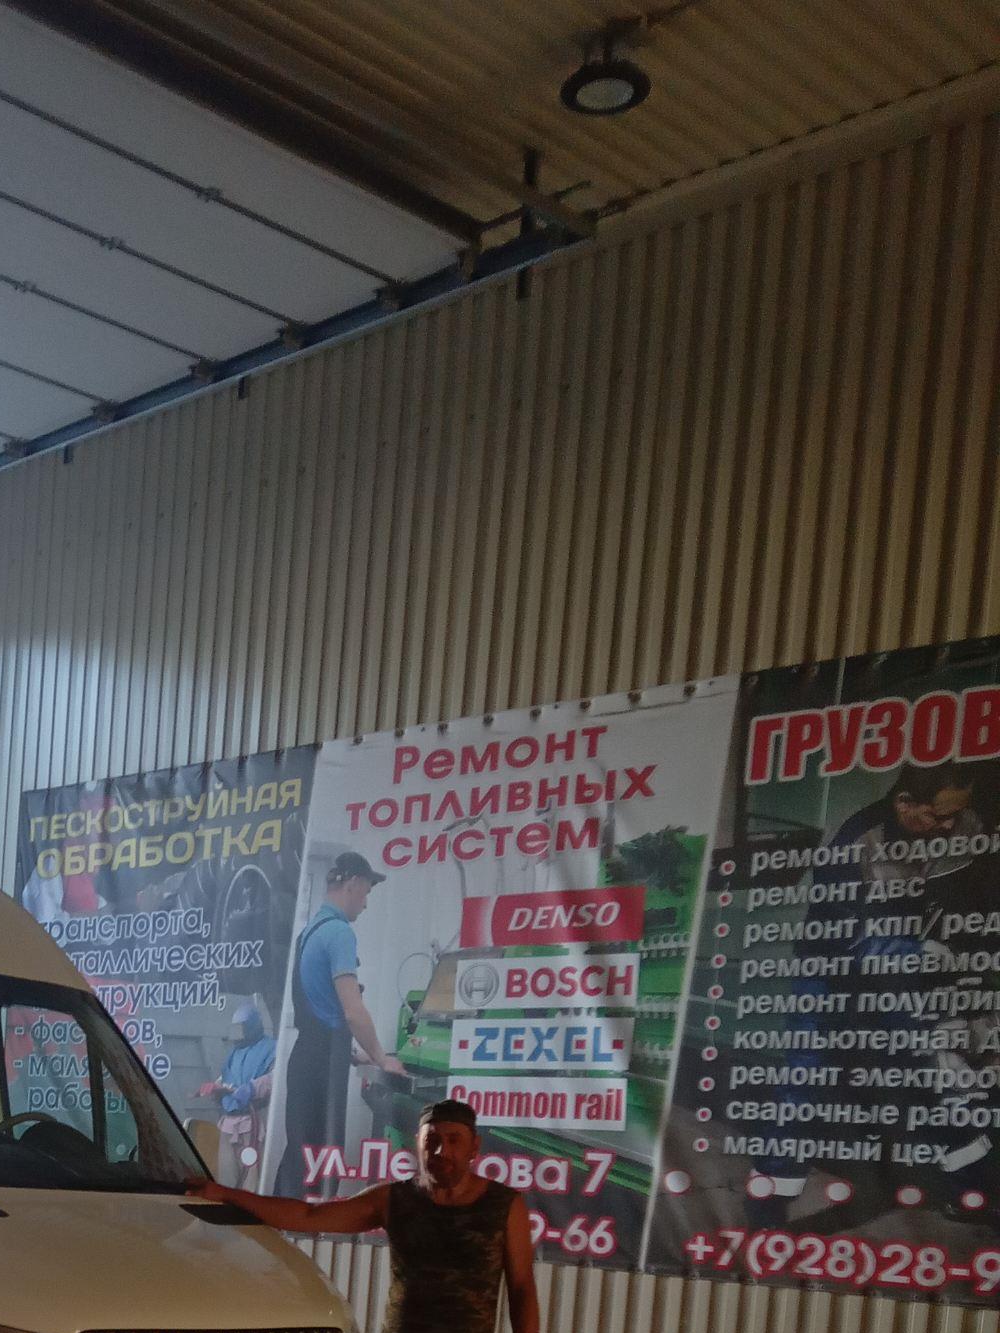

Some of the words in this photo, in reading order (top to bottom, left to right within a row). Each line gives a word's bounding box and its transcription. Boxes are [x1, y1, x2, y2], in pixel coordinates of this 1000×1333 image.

[392, 725, 609, 784] Ремонт
[29, 778, 302, 842] ПЕСКОСТРУЙНАЯ
[346, 764, 658, 831] топливных
[36, 819, 282, 879] ОБРАБОТКА
[382, 817, 600, 868] систем
[750, 843, 866, 877] ремонт
[747, 881, 862, 912] ремонт
[507, 901, 621, 932] DENSO
[743, 918, 860, 949] ремонт
[68, 940, 264, 976] таллических
[740, 956, 855, 984] ремонт
[98, 973, 227, 1016] трукций,
[505, 965, 634, 998] BOSCH
[737, 993, 851, 1019] ремонт
[472, 1026, 615, 1062] ZEXEL
[733, 1028, 971, 1056] компьютерная
[729, 1065, 843, 1089] ремонт
[849, 1066, 1000, 1093] электроо
[574, 1089, 624, 1121] rail
[725, 1101, 900, 1126] сварочные
[723, 1135, 883, 1163] малярный
[891, 1143, 951, 1167] цех
[584, 1152, 614, 1194] 7
